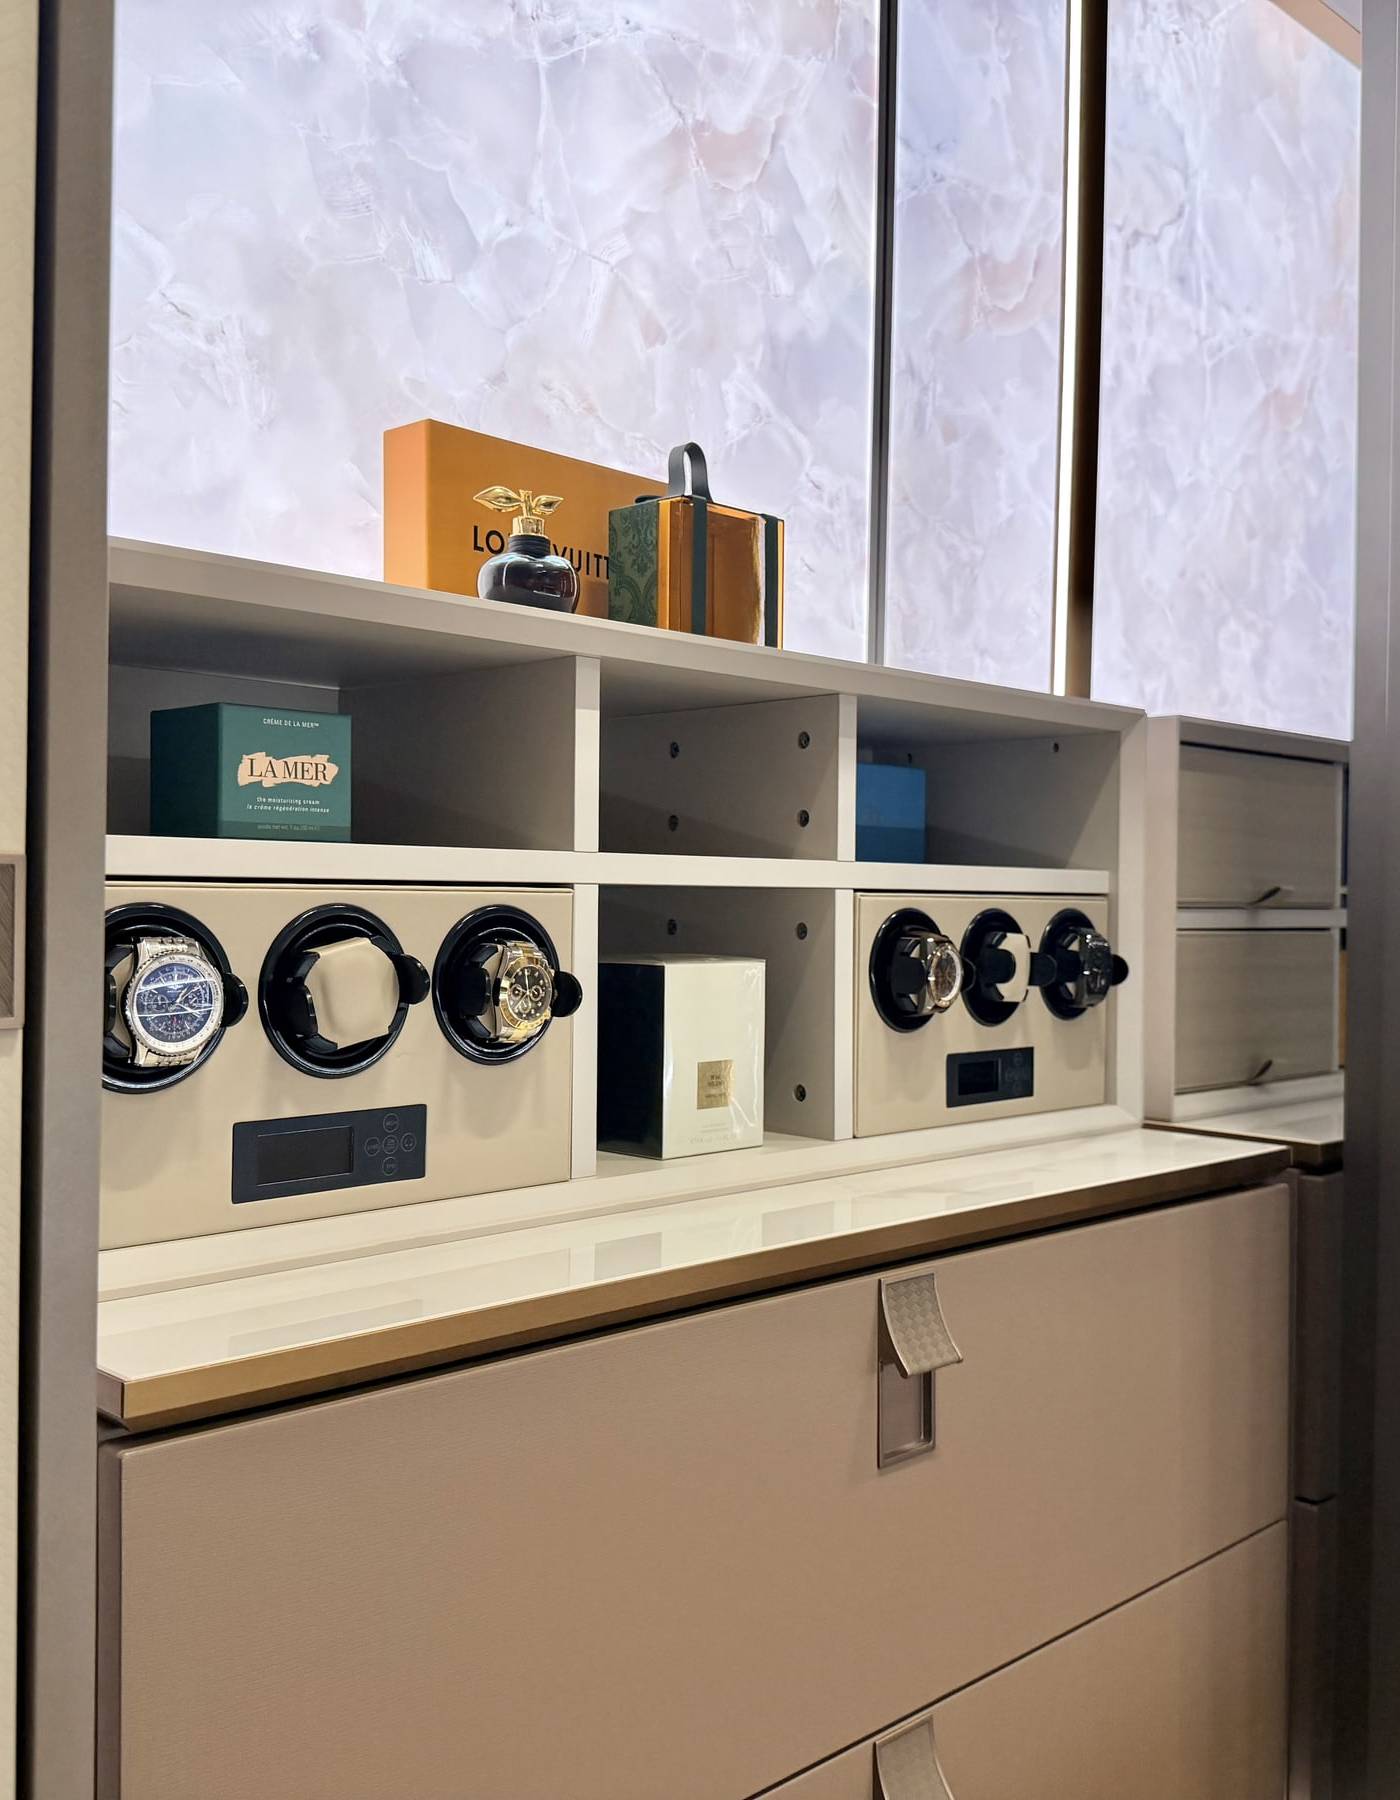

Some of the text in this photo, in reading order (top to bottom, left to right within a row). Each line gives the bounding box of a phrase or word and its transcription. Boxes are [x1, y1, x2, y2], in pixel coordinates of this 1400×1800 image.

[552, 543, 609, 580] VUITT
[283, 719, 292, 727] DE
[293, 720, 301, 728] LA
[247, 757, 329, 782] LA MER
